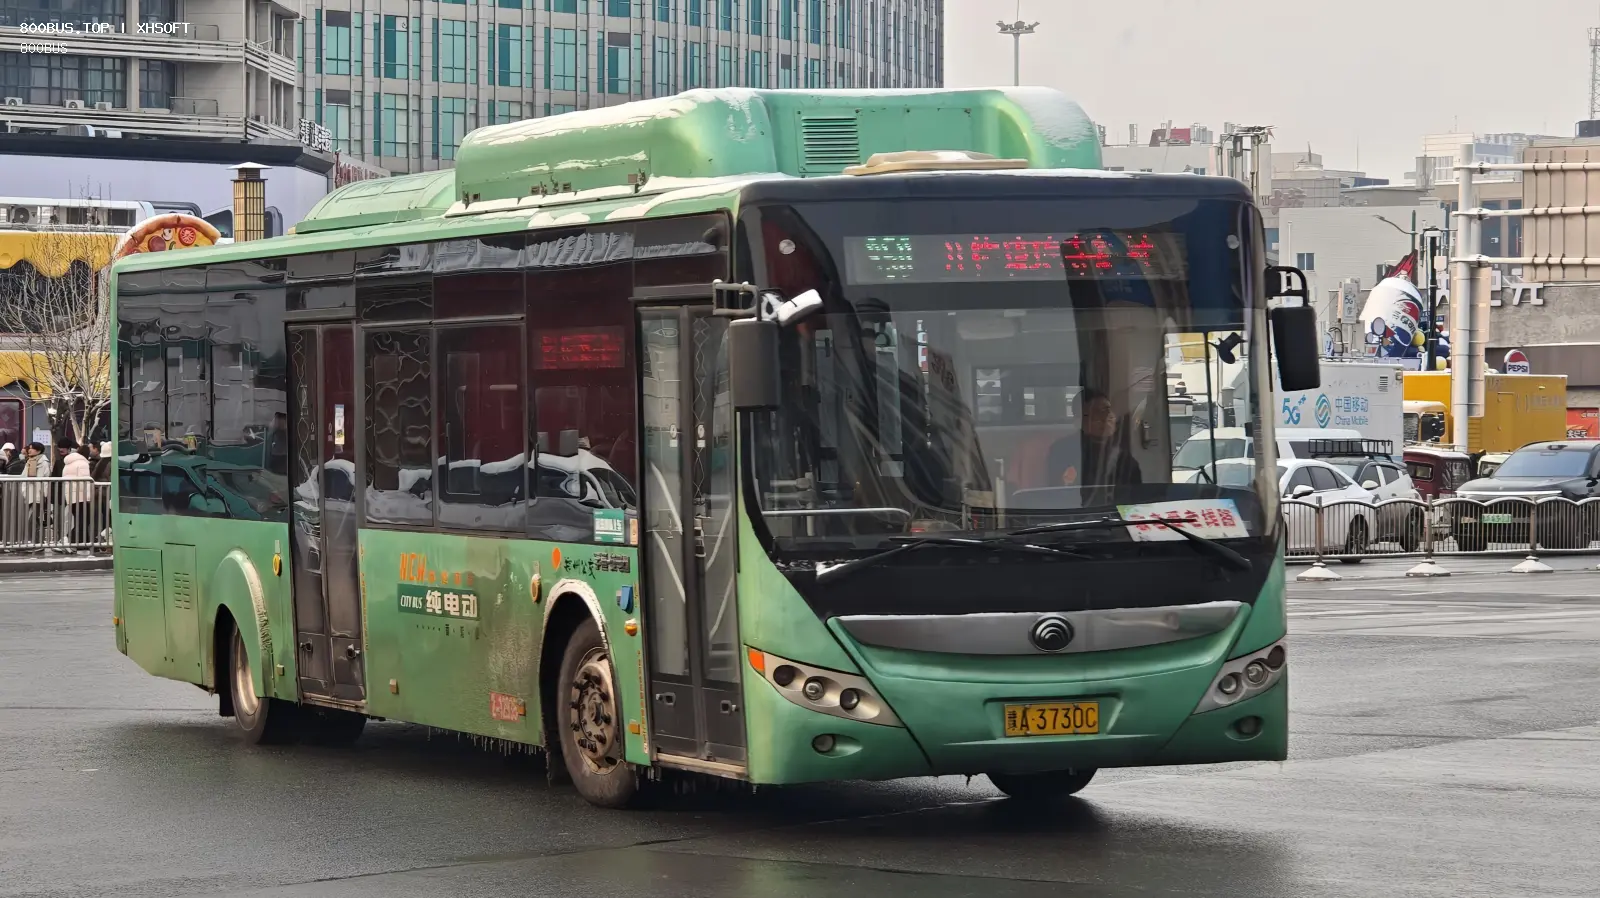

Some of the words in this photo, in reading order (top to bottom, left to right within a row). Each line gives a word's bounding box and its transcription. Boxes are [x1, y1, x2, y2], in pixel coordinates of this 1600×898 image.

[1508, 364, 1528, 373] PEPSI
[1335, 396, 1369, 413] 中国移动
[1335, 415, 1350, 425] China
[1351, 415, 1368, 425] Mobile
[400, 595, 411, 608] CITY
[412, 596, 423, 609] BUS
[426, 589, 478, 618] 纯电动
